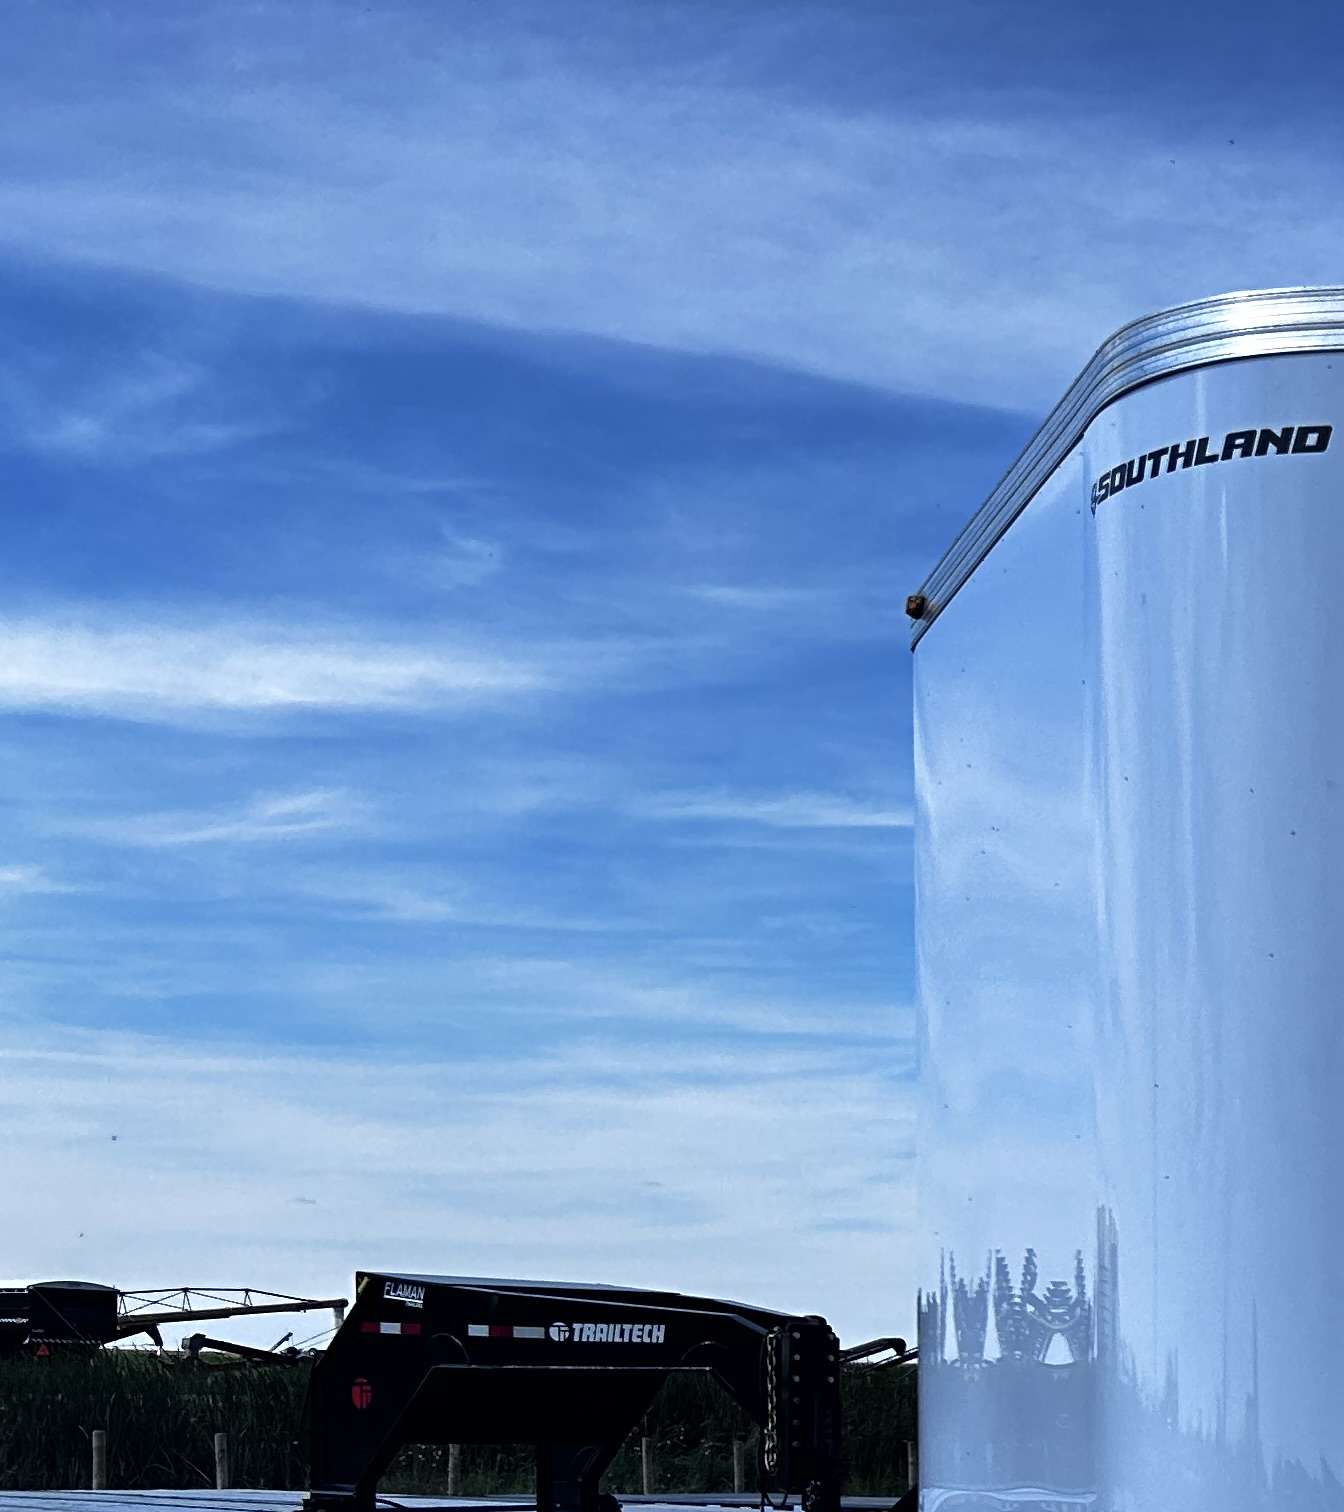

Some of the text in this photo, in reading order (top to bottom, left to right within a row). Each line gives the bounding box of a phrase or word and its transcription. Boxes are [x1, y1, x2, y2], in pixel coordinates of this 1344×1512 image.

[1096, 424, 1333, 505] SOUTHLAND
[383, 1281, 426, 1300] FLAMAN
[572, 1322, 666, 1343] TRAILTECH
